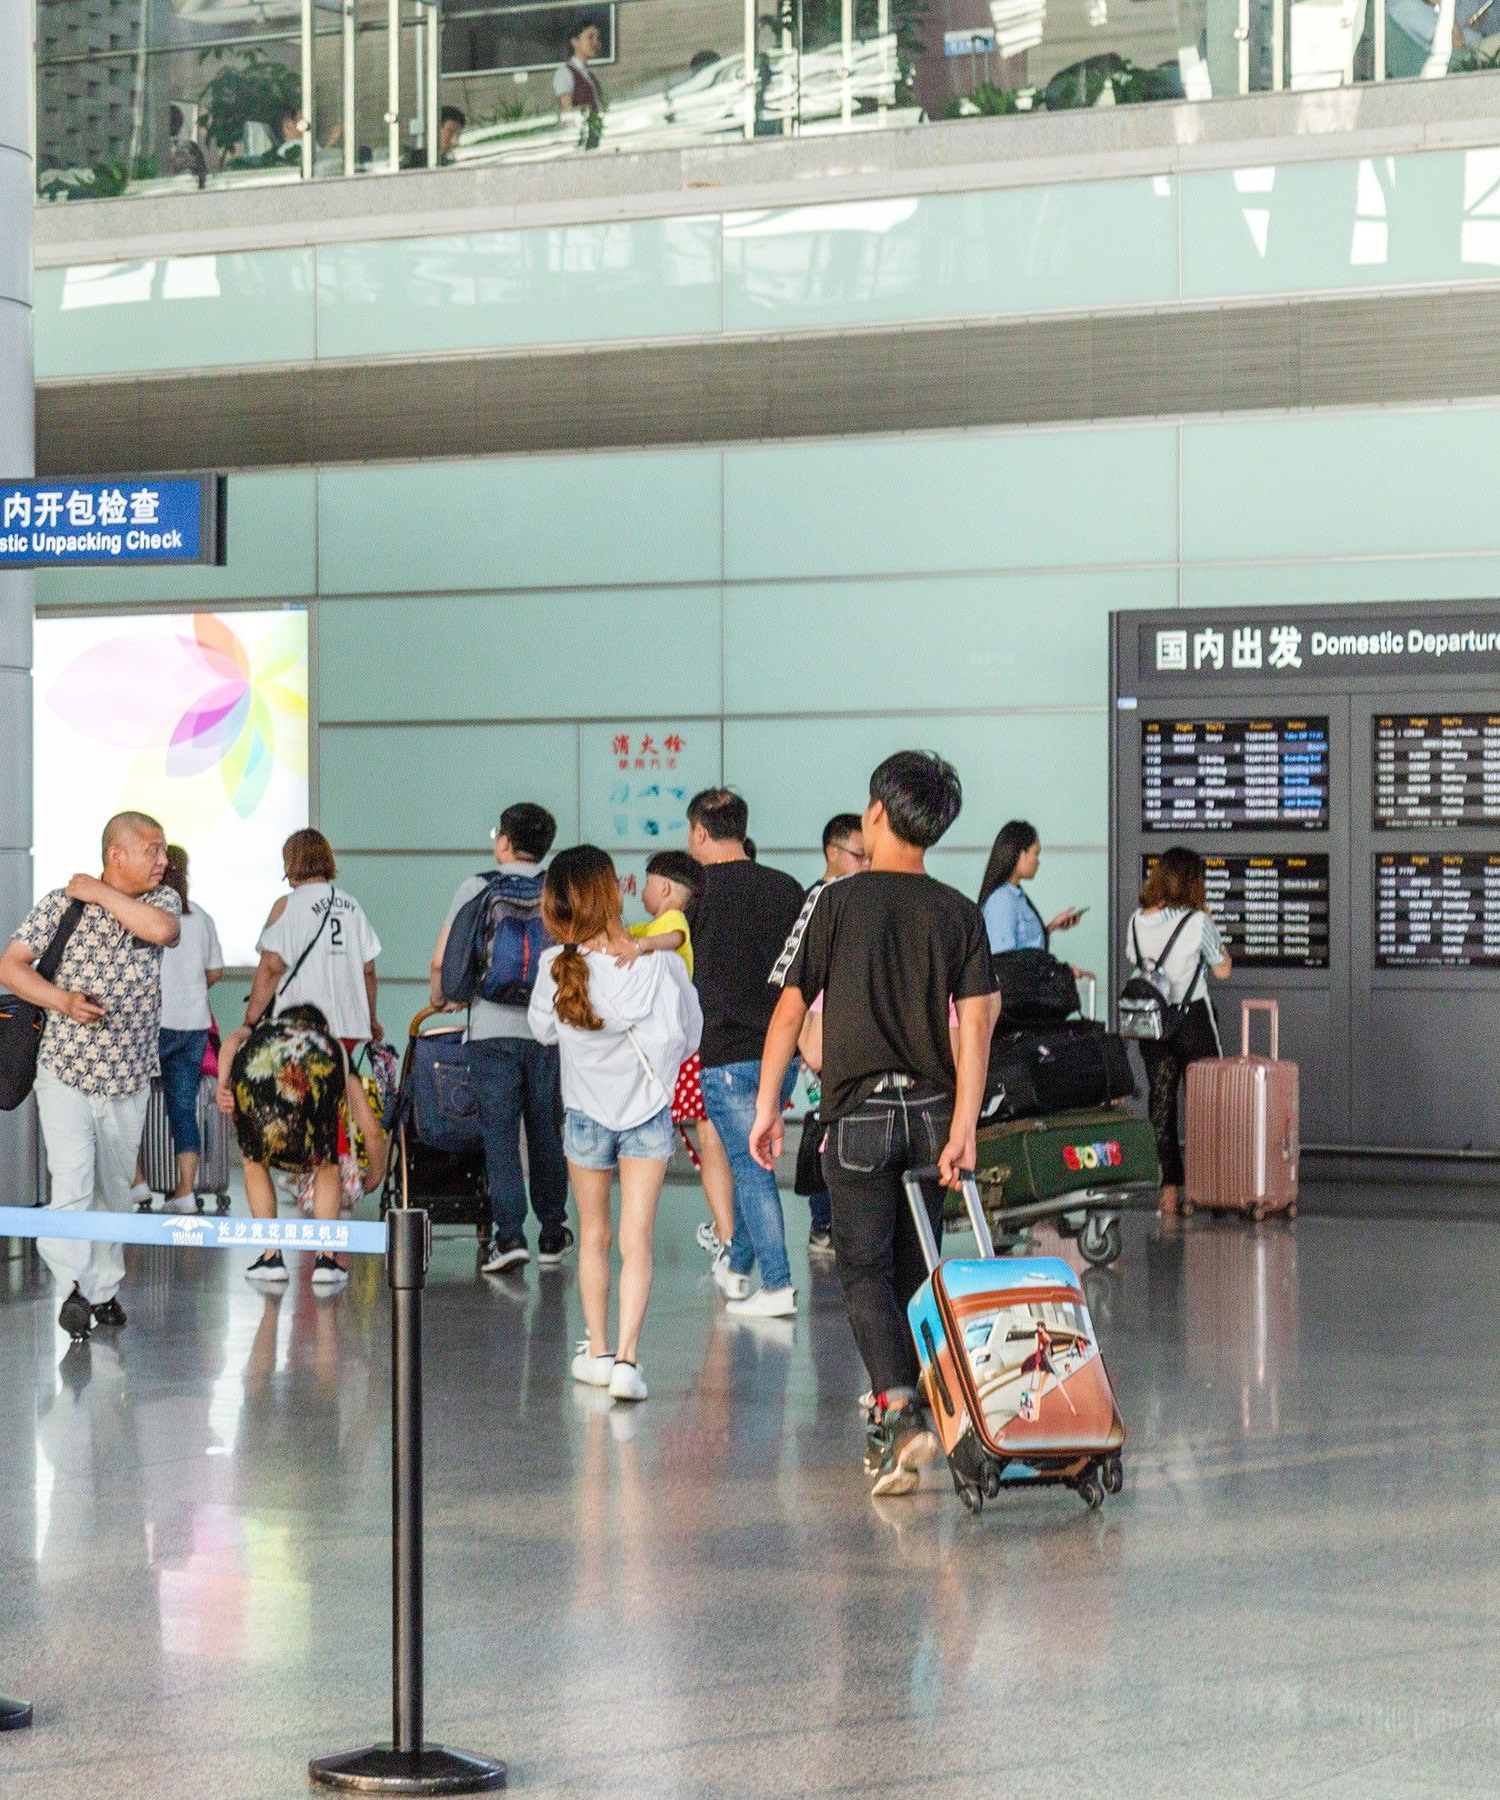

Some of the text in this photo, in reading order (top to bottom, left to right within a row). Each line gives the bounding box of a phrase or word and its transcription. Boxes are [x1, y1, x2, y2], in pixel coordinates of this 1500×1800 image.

[32, 531, 122, 555] Unpacking
[126, 530, 182, 549] Check
[1156, 627, 1302, 670] 国内出发
[1311, 630, 1404, 655] Domestic
[330, 917, 343, 946] 2
[218, 1221, 349, 1241] 长沙黄花国际机场
